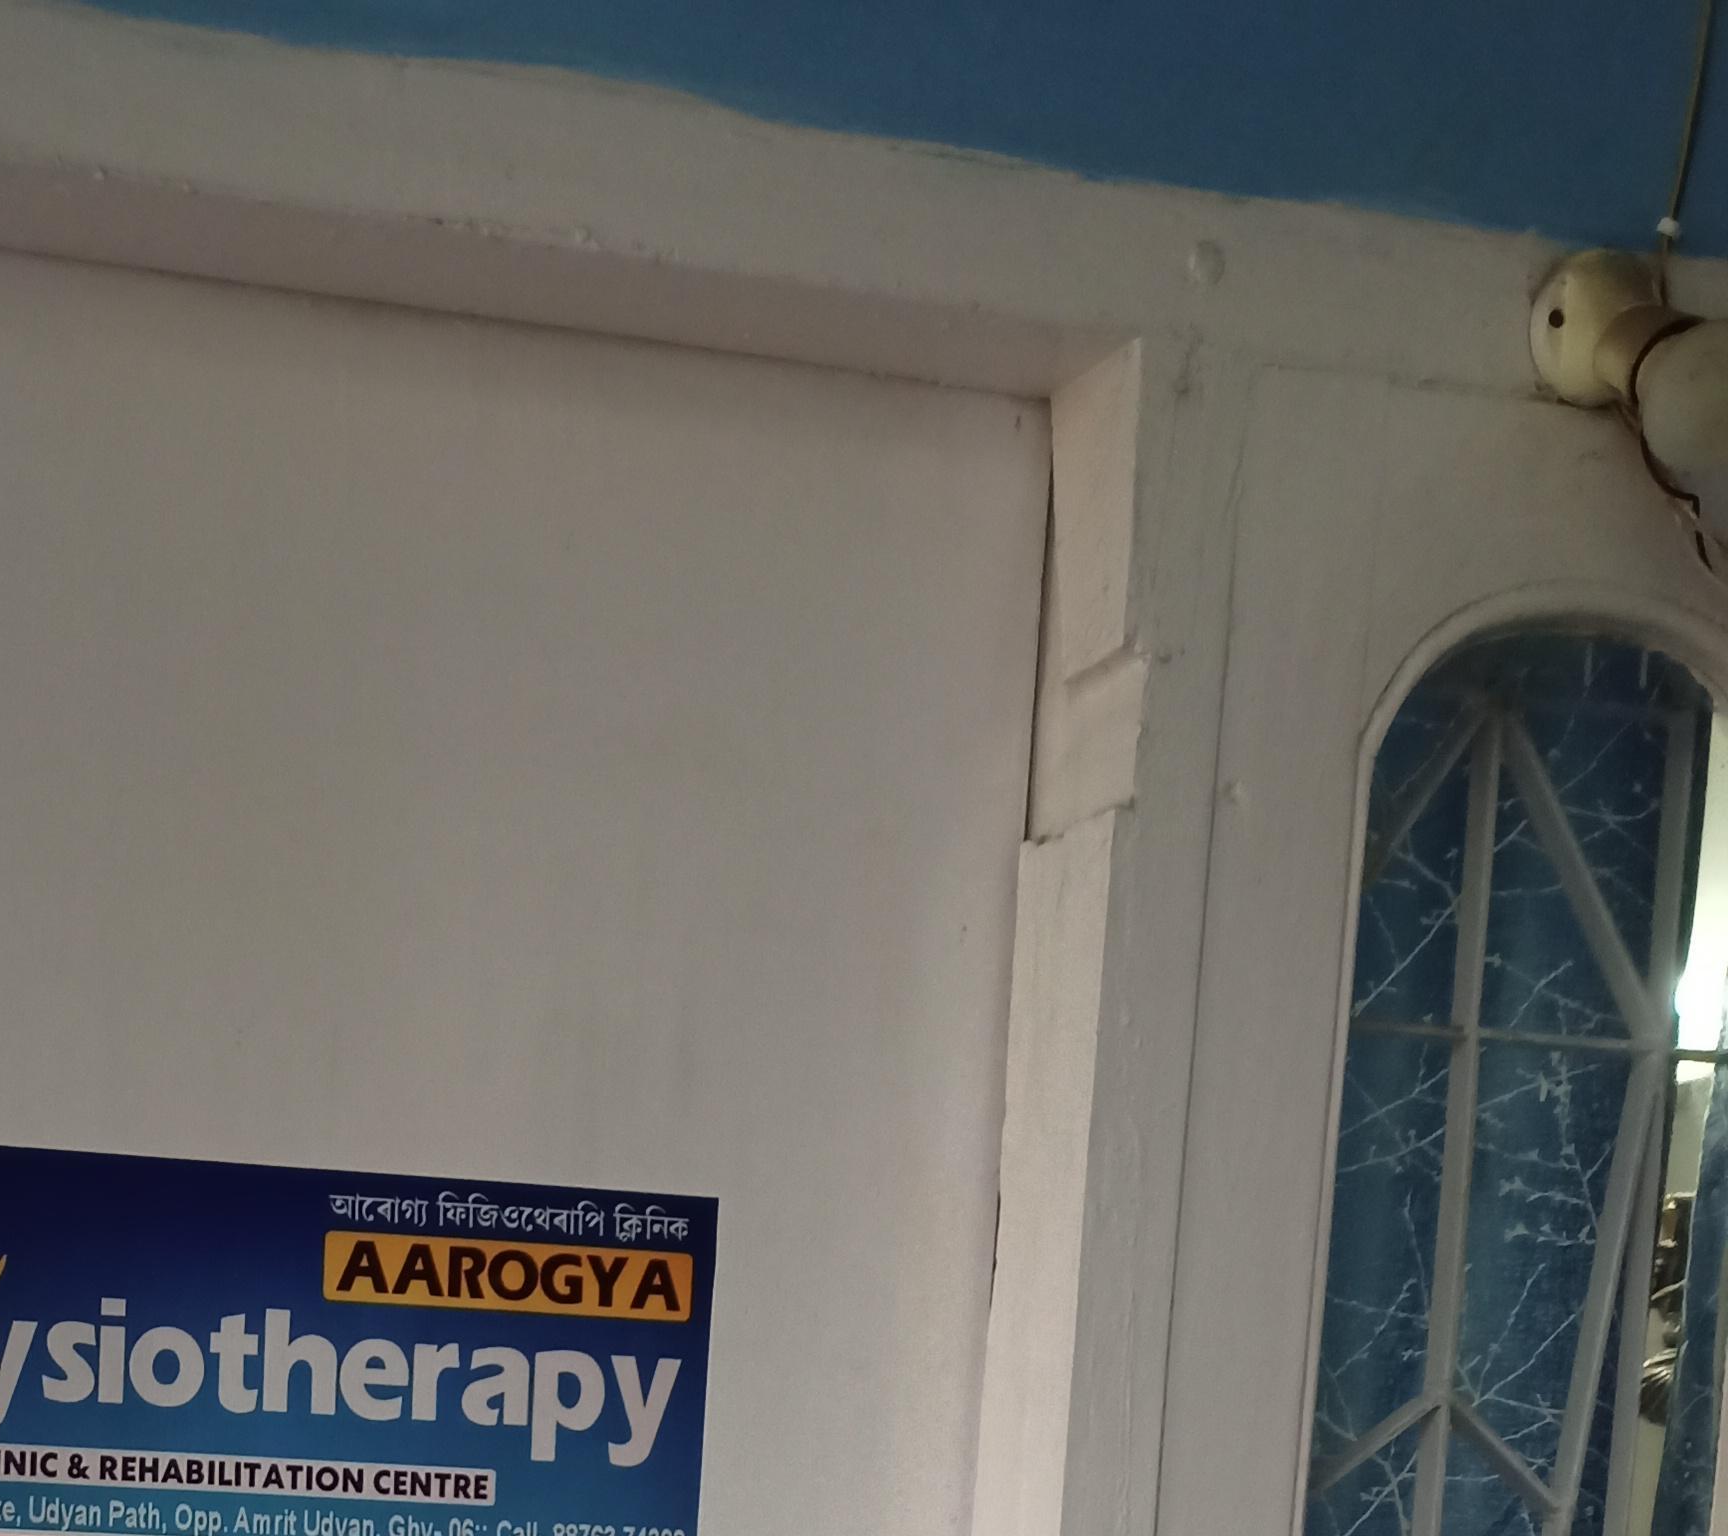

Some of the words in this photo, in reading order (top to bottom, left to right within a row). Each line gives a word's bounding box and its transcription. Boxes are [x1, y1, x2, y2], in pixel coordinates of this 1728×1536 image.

[336, 1240, 681, 1311] AAROGYA
[67, 1454, 90, 1480] &
[99, 1455, 364, 1494] REHABILITATION
[373, 1469, 489, 1499] CENTRE
[28, 1496, 101, 1531] Udyan
[108, 1500, 167, 1534] Path,
[233, 1507, 297, 1536] Amrit
